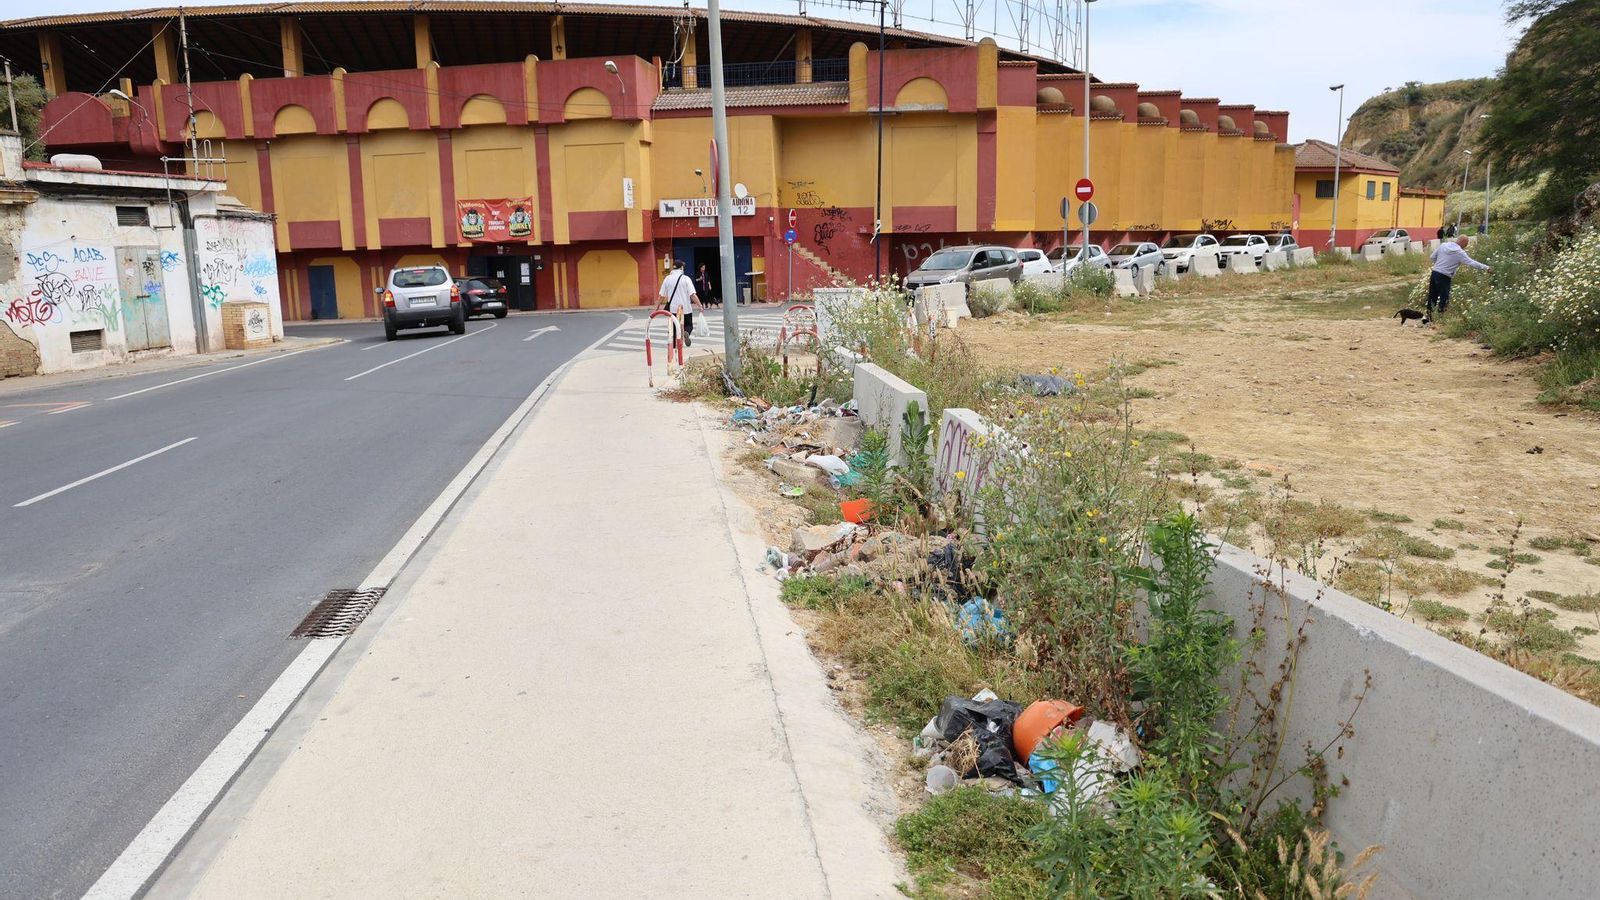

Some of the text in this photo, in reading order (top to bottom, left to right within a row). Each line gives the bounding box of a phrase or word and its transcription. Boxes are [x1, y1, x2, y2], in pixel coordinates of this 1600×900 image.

[732, 198, 753, 206] AURINA
[686, 206, 749, 216] TENDI 12
